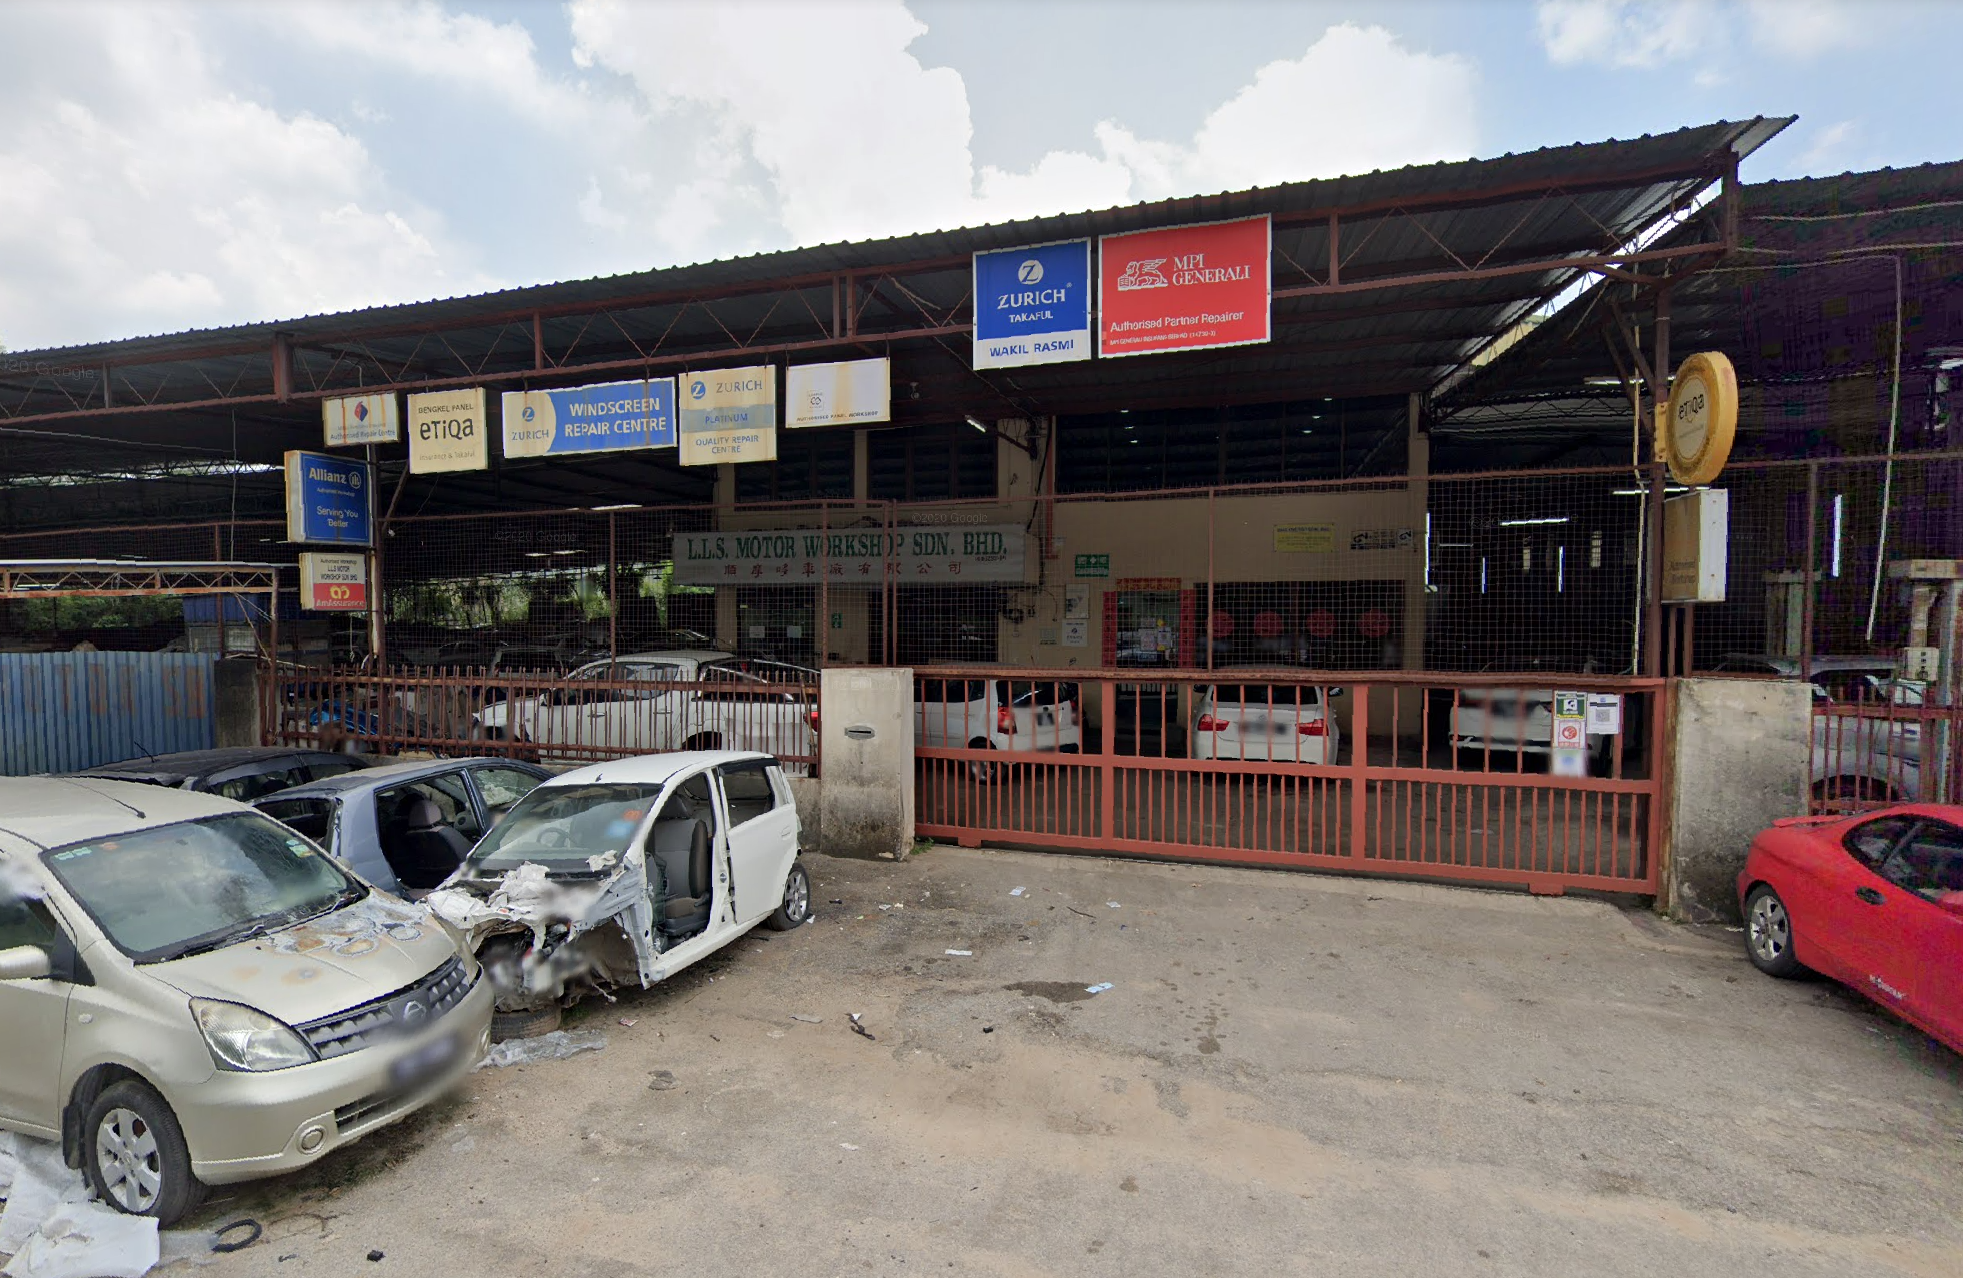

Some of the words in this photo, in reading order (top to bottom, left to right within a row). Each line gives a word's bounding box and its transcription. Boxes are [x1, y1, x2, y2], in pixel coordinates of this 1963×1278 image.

[1173, 254, 1205, 271] MPI
[1172, 265, 1251, 286] GENERALI
[1008, 311, 1054, 323] TAKAFUL
[1110, 317, 1162, 332] Authorised
[1164, 314, 1200, 328] Partner
[1201, 311, 1245, 325] Repairer
[990, 344, 1029, 357] WAKIL
[1034, 339, 1074, 352] RASMI
[716, 380, 763, 393] ZURICH
[418, 404, 450, 414] BENGKEL
[452, 403, 474, 412] PANEL
[569, 397, 660, 417] WINDSCREEN
[705, 413, 748, 424] PLATINUM
[565, 421, 610, 437] REPAIR
[614, 417, 667, 434] CENTRE
[511, 429, 549, 441] ZURICH
[695, 436, 730, 446] QUALITY
[732, 434, 759, 444] REPAIR
[711, 445, 741, 454] CENTRE
[309, 467, 347, 484] Allianz
[316, 505, 344, 518] Serving
[344, 509, 359, 518] You
[327, 518, 348, 528] Better
[736, 535, 797, 559] MOTOR
[803, 533, 905, 558] WORKSHOP
[912, 531, 955, 556] SDN.
[963, 531, 1008, 556] BHD.
